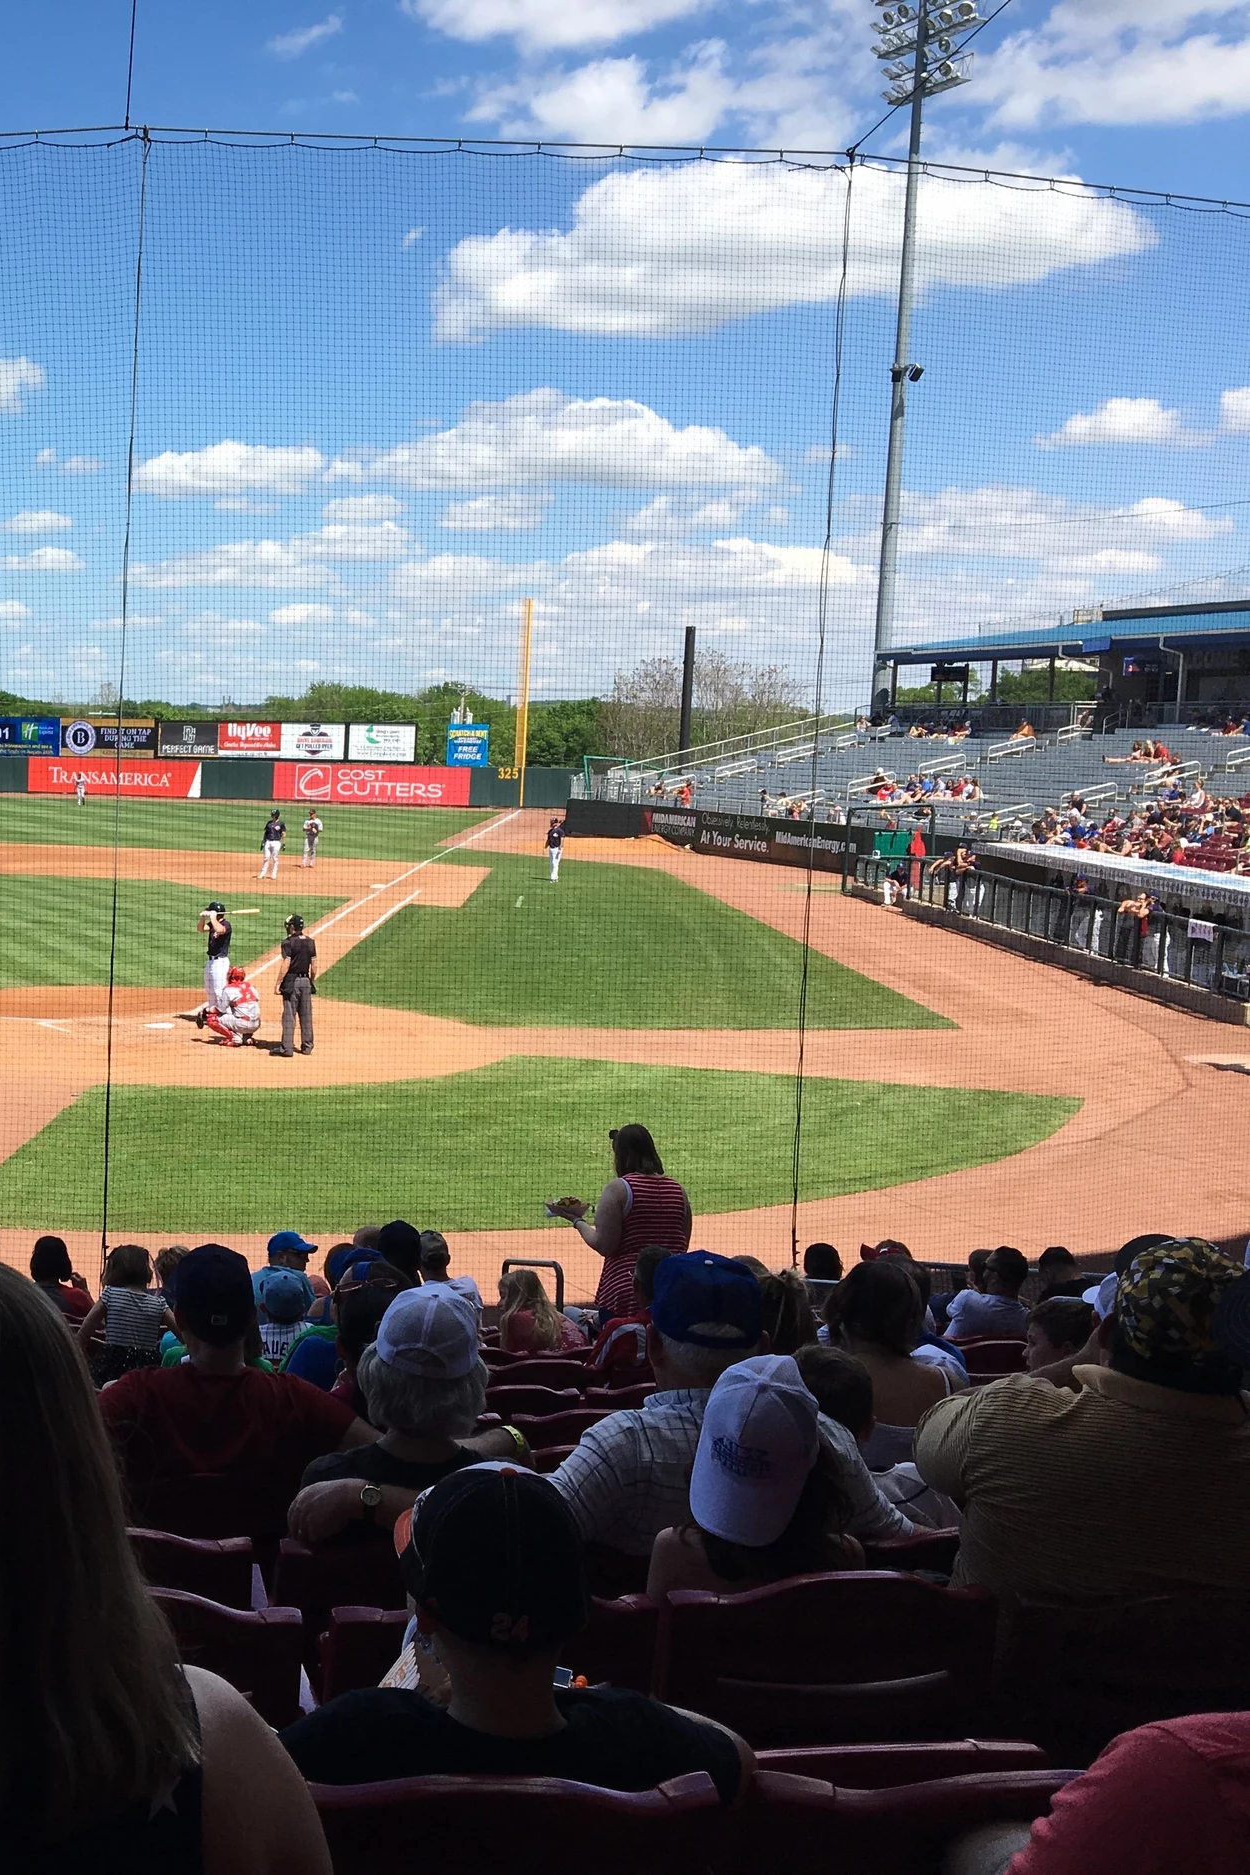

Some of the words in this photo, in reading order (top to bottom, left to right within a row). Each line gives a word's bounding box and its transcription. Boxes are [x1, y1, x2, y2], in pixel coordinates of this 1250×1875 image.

[76, 731, 86, 744] B
[100, 727, 117, 735] FIND
[138, 728, 152, 736] TAP
[227, 723, 272, 741] HyVee
[162, 744, 192, 754] PERFECT
[193, 745, 215, 754] GAME
[457, 745, 478, 753] FREE
[48, 766, 171, 788] TRANSAMERICA
[337, 769, 386, 781] COST
[497, 767, 519, 780] 325
[337, 781, 443, 798] CUTTERS
[651, 812, 697, 828] MIDAMERICAN
[651, 822, 672, 835] ENERGY
[671, 824, 696, 838] COMPANY
[700, 829, 711, 844] At
[712, 832, 732, 848] Your
[733, 833, 770, 853] Service.
[775, 830, 857, 854] MidAmericanEnergy.cm
[490, 1612, 530, 1642] 24
